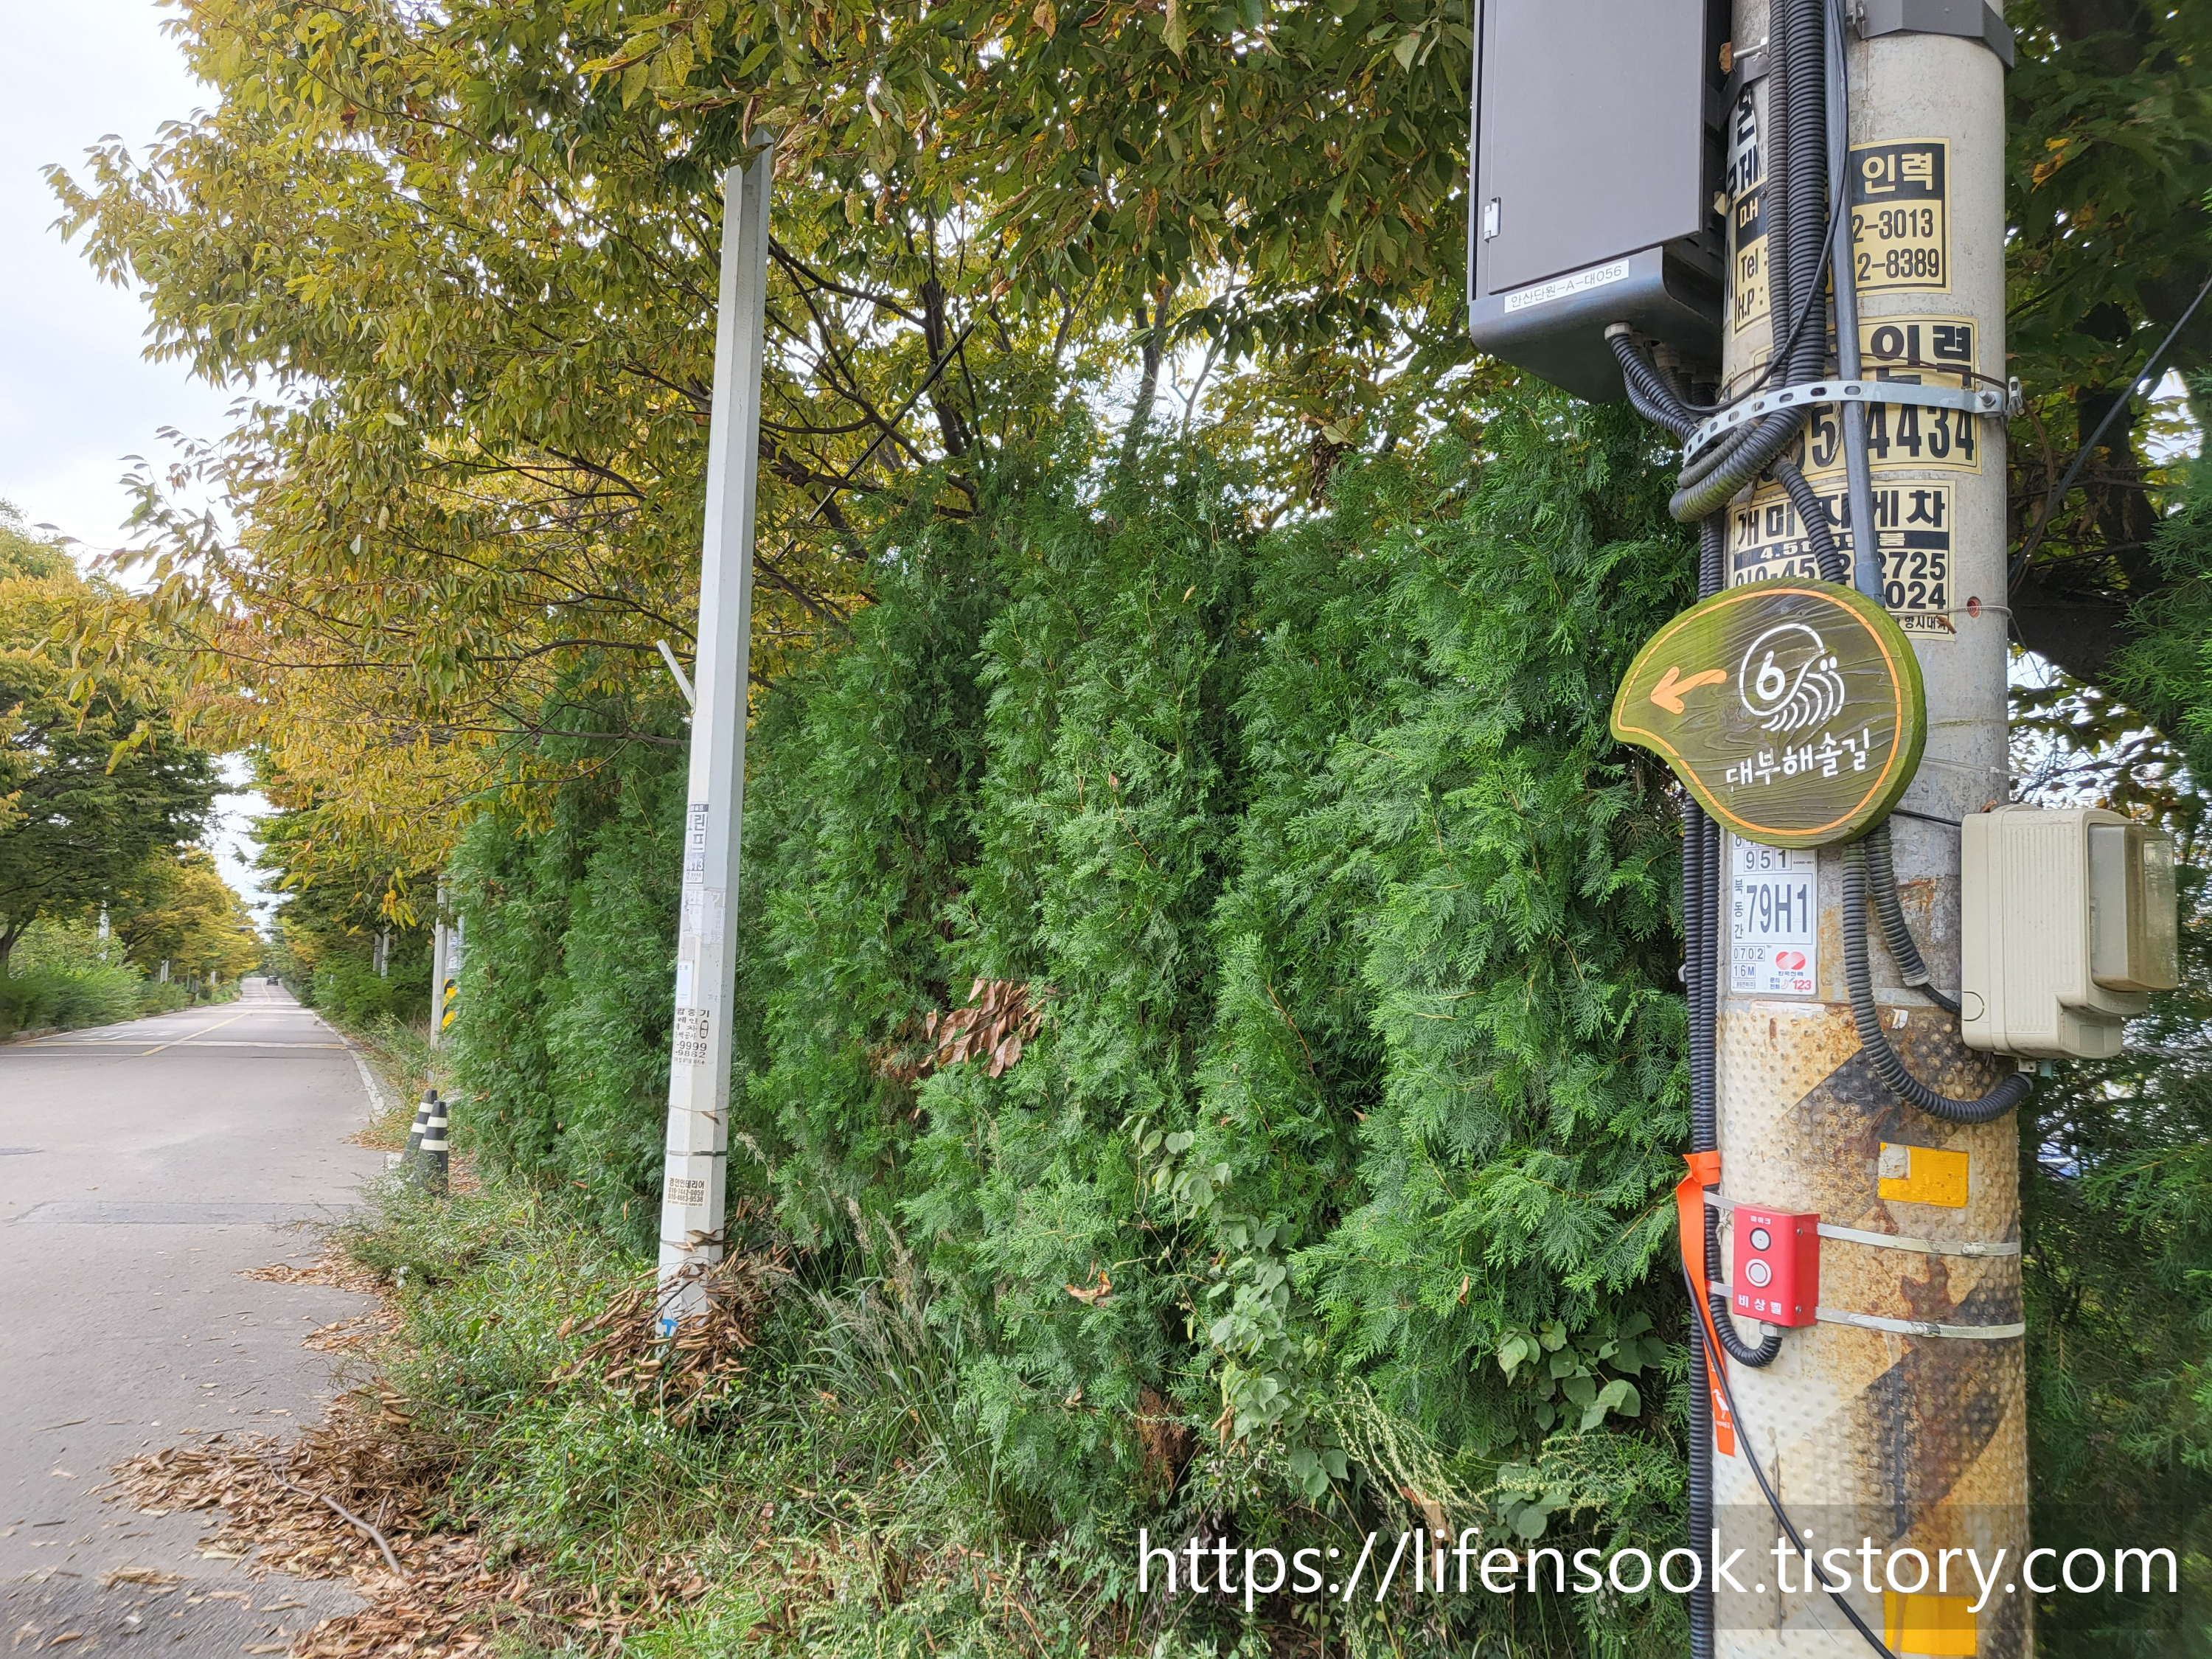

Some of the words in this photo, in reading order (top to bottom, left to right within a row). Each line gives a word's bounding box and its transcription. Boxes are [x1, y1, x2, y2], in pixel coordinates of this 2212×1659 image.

[1862, 152, 1933, 195] 인력
[1739, 201, 1759, 229] D.H
[1740, 247, 1759, 283] Tel
[1511, 265, 1623, 309] 안산단원-A-대056
[1738, 287, 1755, 323] H.P
[1870, 324, 1972, 389] 인력
[1885, 580, 1947, 610] 024
[1756, 650, 1786, 700] 6
[1726, 727, 1870, 793] 대부해솔길
[1745, 849, 1787, 870] 951
[1746, 883, 1808, 933] 79H1
[1733, 947, 1764, 960] 0702
[1733, 964, 1755, 977] 16M
[1792, 979, 1812, 990] 123
